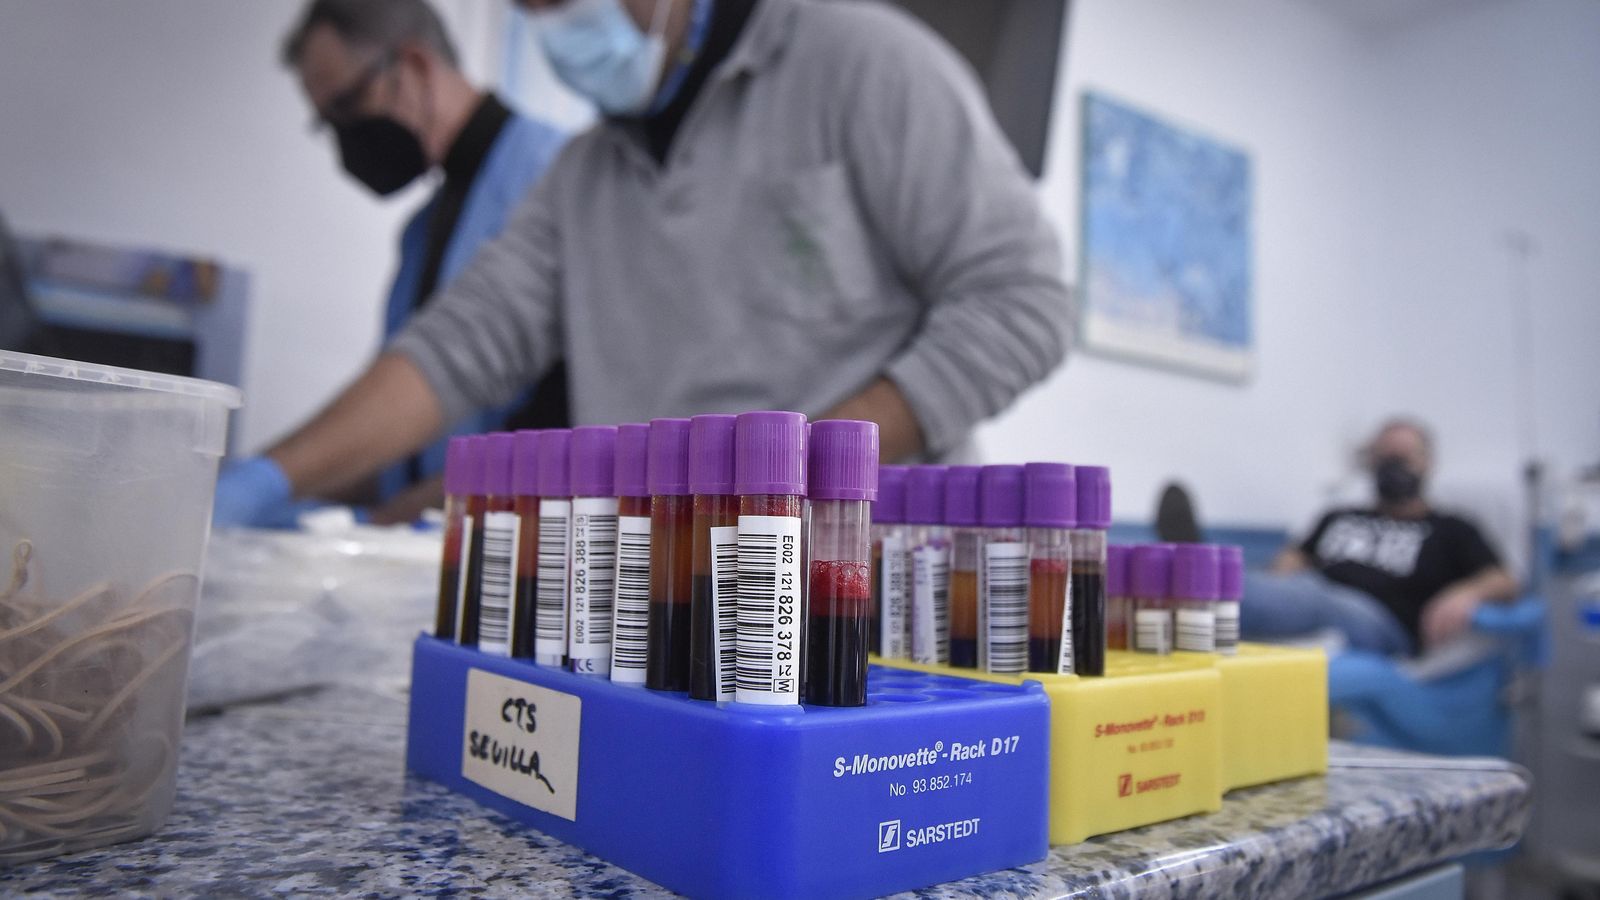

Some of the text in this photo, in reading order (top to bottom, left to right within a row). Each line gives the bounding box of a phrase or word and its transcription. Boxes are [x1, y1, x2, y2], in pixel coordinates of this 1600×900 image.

[575, 540, 586, 565] 388
[782, 535, 793, 564] E002
[575, 569, 586, 594] 826
[781, 572, 793, 591] 121
[778, 595, 793, 625] 826
[777, 631, 792, 660] 378
[502, 698, 536, 733] CTS
[991, 736, 1020, 756] D17
[469, 730, 555, 794] SEVILLA
[912, 772, 972, 794] 93.852.174
[906, 818, 980, 848] SARSTEDT
